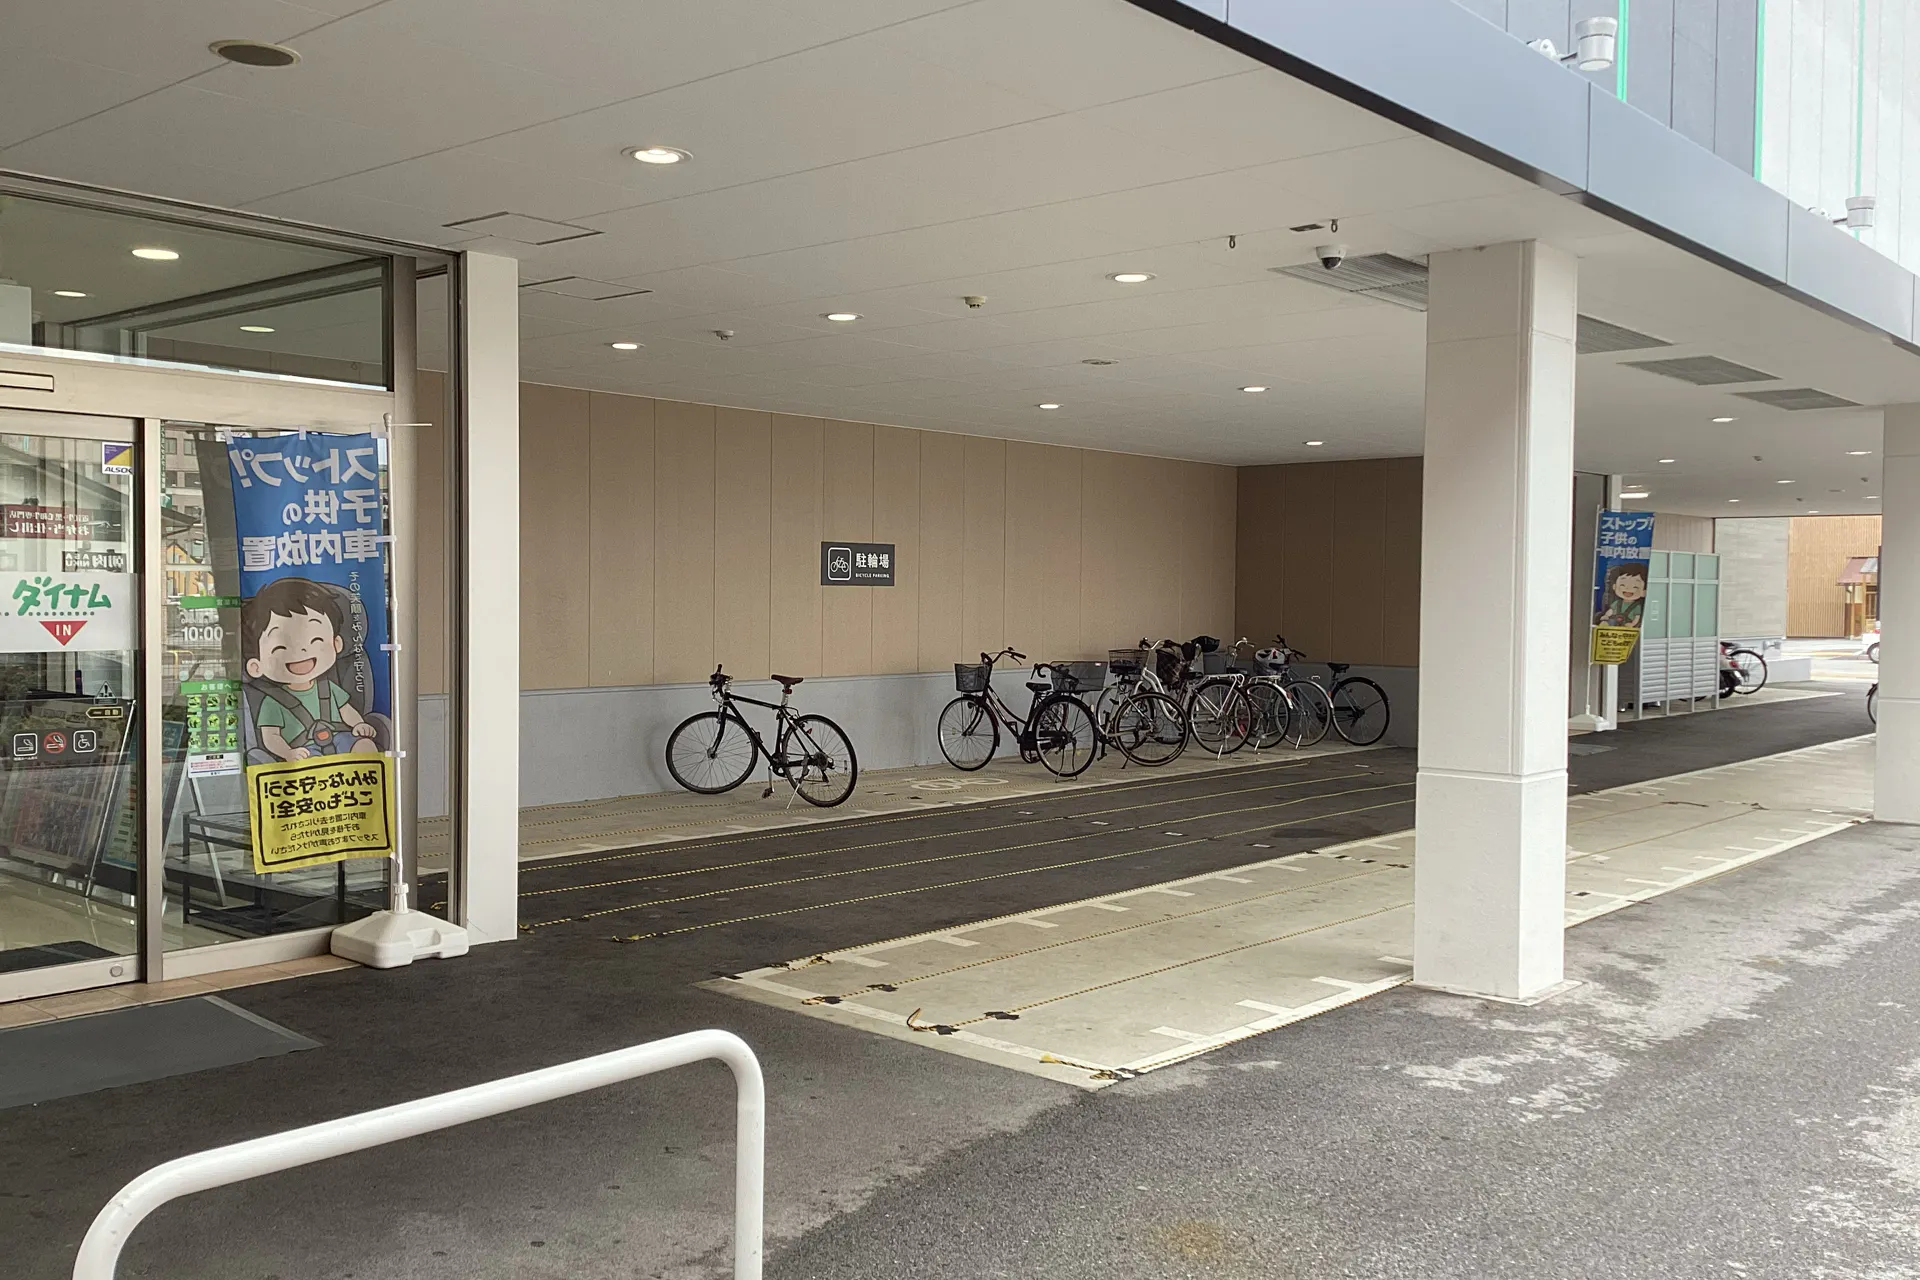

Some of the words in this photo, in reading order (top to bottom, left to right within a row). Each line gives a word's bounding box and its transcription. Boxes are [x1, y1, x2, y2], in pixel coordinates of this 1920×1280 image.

[1601, 532, 1637, 545] 子供の
[1600, 546, 1650, 559] 車内放置
[855, 553, 889, 568] 駐輪場
[12, 576, 112, 616] ダイナム
[55, 624, 72, 636] IN
[181, 626, 223, 642] 10:00
